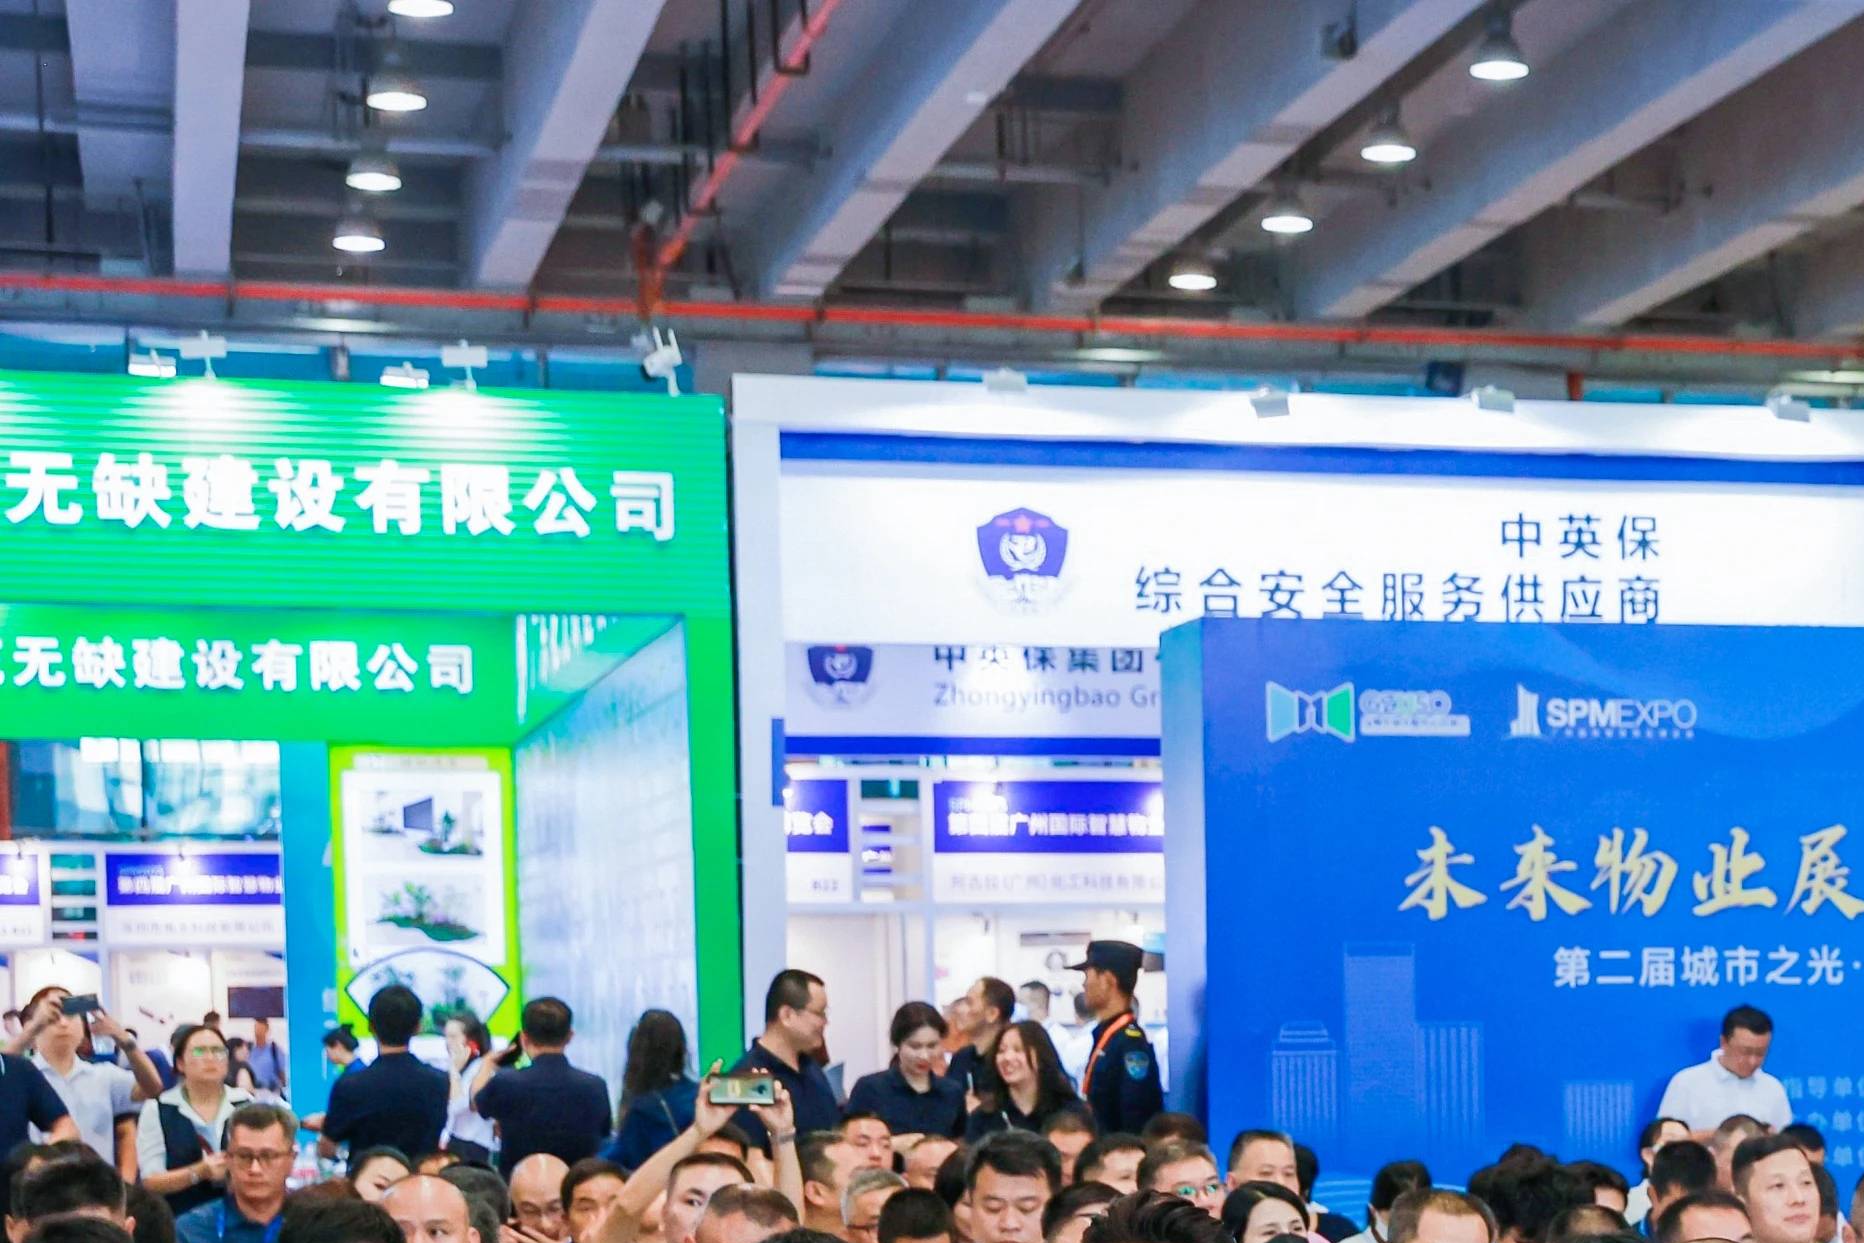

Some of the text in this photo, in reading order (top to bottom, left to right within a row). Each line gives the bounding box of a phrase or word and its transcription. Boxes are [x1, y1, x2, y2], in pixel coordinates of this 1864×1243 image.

[4, 452, 678, 543] 无缺建设有限公司
[1501, 513, 1660, 560] 中英保
[1135, 565, 1661, 624] 综合安全服务供应商
[0, 636, 475, 692] 无缺建设有限公司
[934, 682, 1121, 713] Zhongyingbao
[1546, 697, 1697, 729] SPMEXPO
